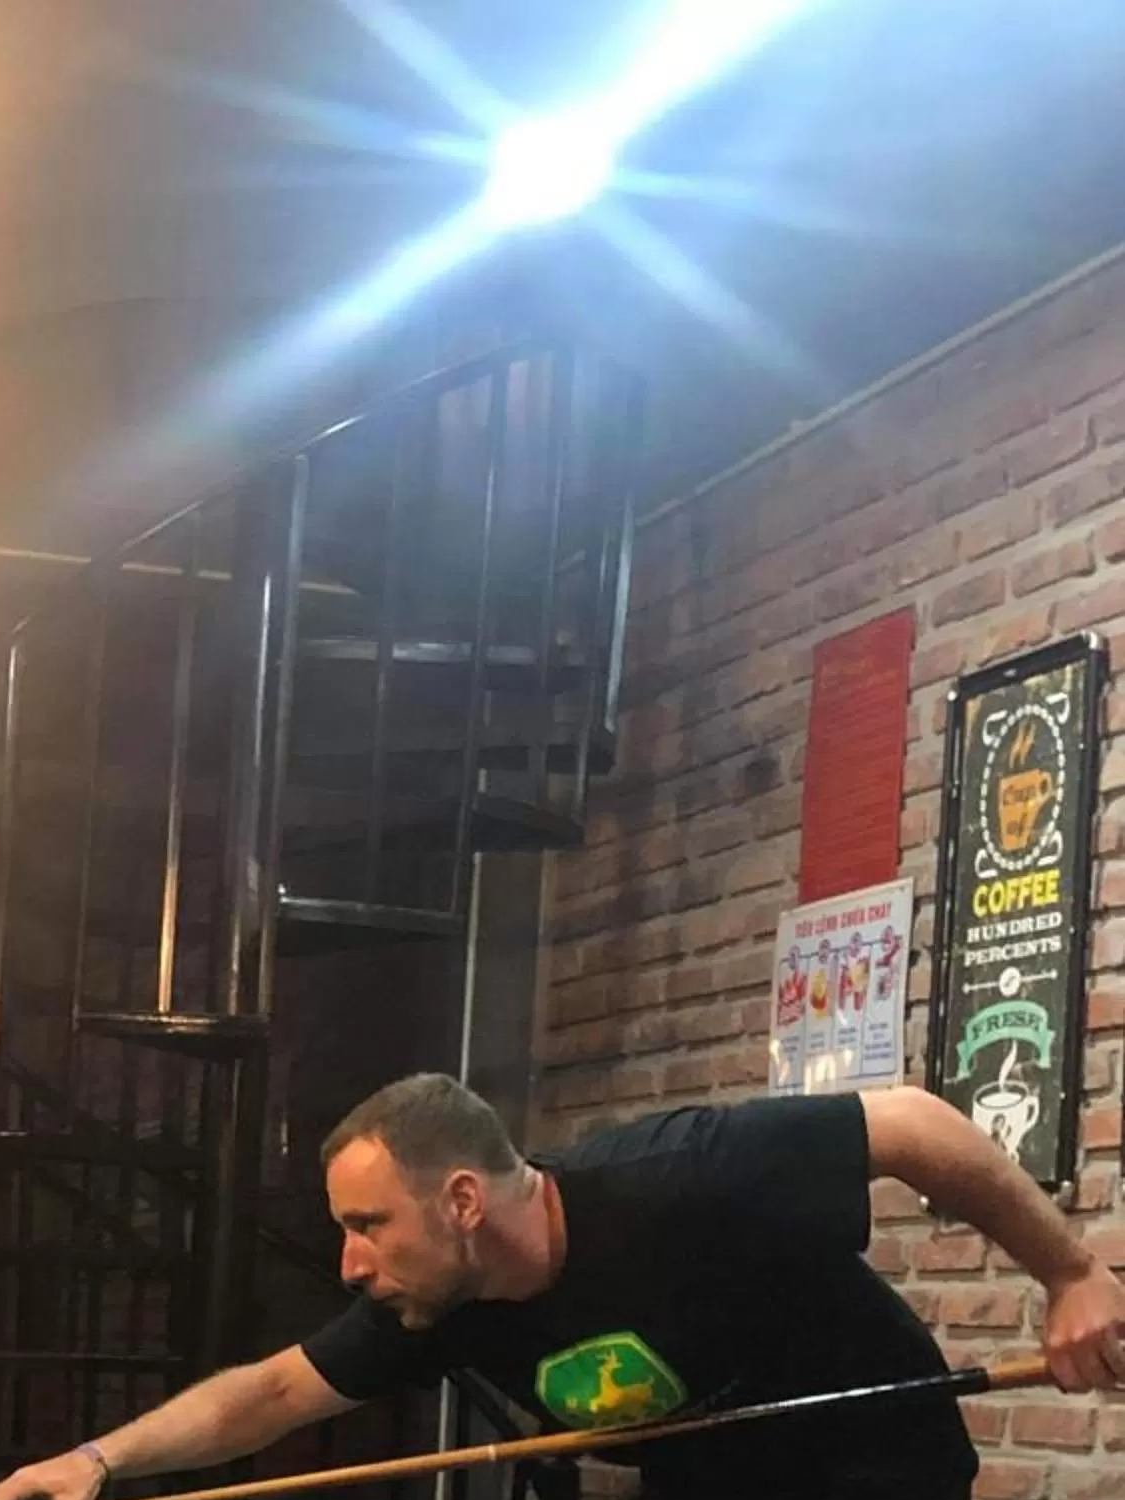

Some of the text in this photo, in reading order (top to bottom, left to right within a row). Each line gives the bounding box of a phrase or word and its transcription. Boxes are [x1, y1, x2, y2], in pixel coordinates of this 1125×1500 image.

[973, 868, 1060, 918] COFFEE
[966, 911, 1063, 943] HUNDRED
[963, 935, 1062, 968] PERCENTS
[972, 1010, 1043, 1041] FRESH
